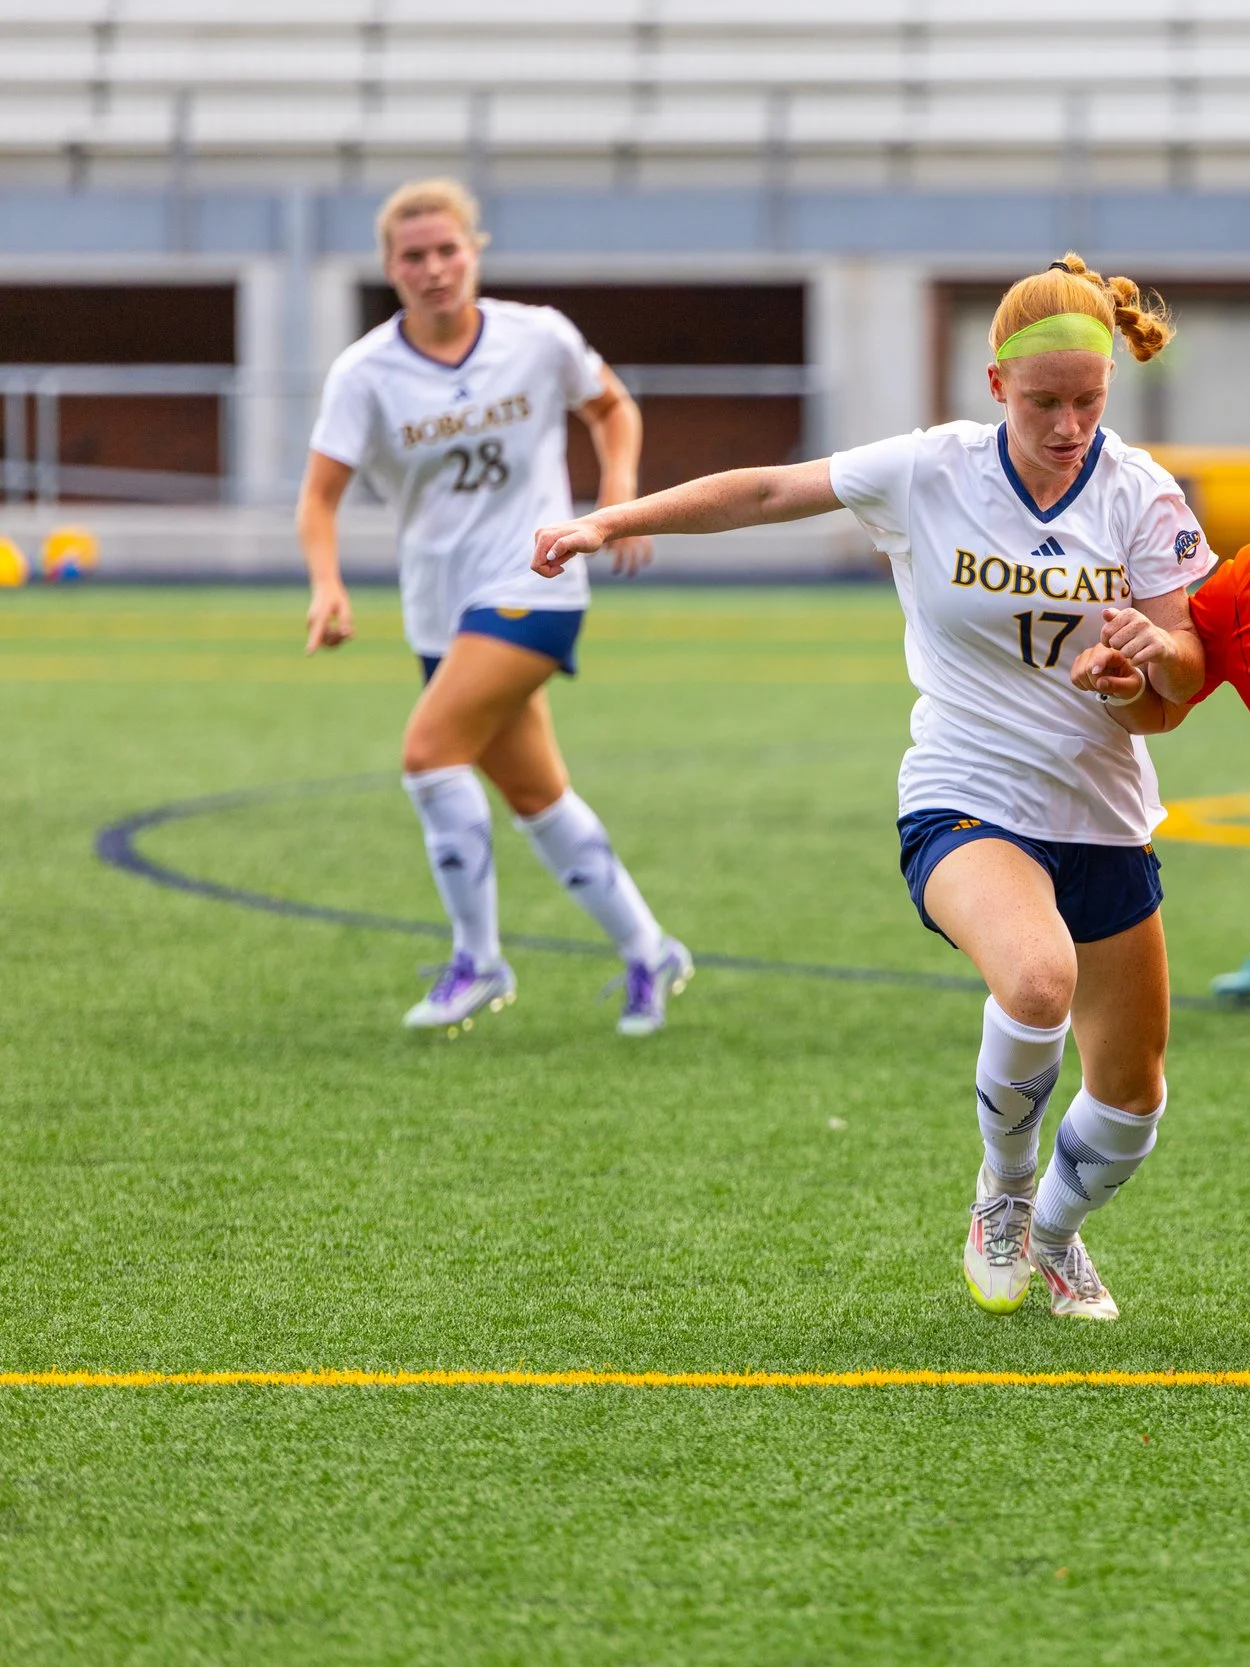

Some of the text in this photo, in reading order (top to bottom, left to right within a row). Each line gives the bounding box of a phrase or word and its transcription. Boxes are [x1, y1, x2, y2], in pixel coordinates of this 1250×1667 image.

[402, 394, 531, 448] BOBCATS
[445, 438, 510, 493] 28
[1173, 530, 1201, 564] MAAC
[951, 548, 1132, 602] BOBCATS
[1013, 610, 1084, 669] 17
